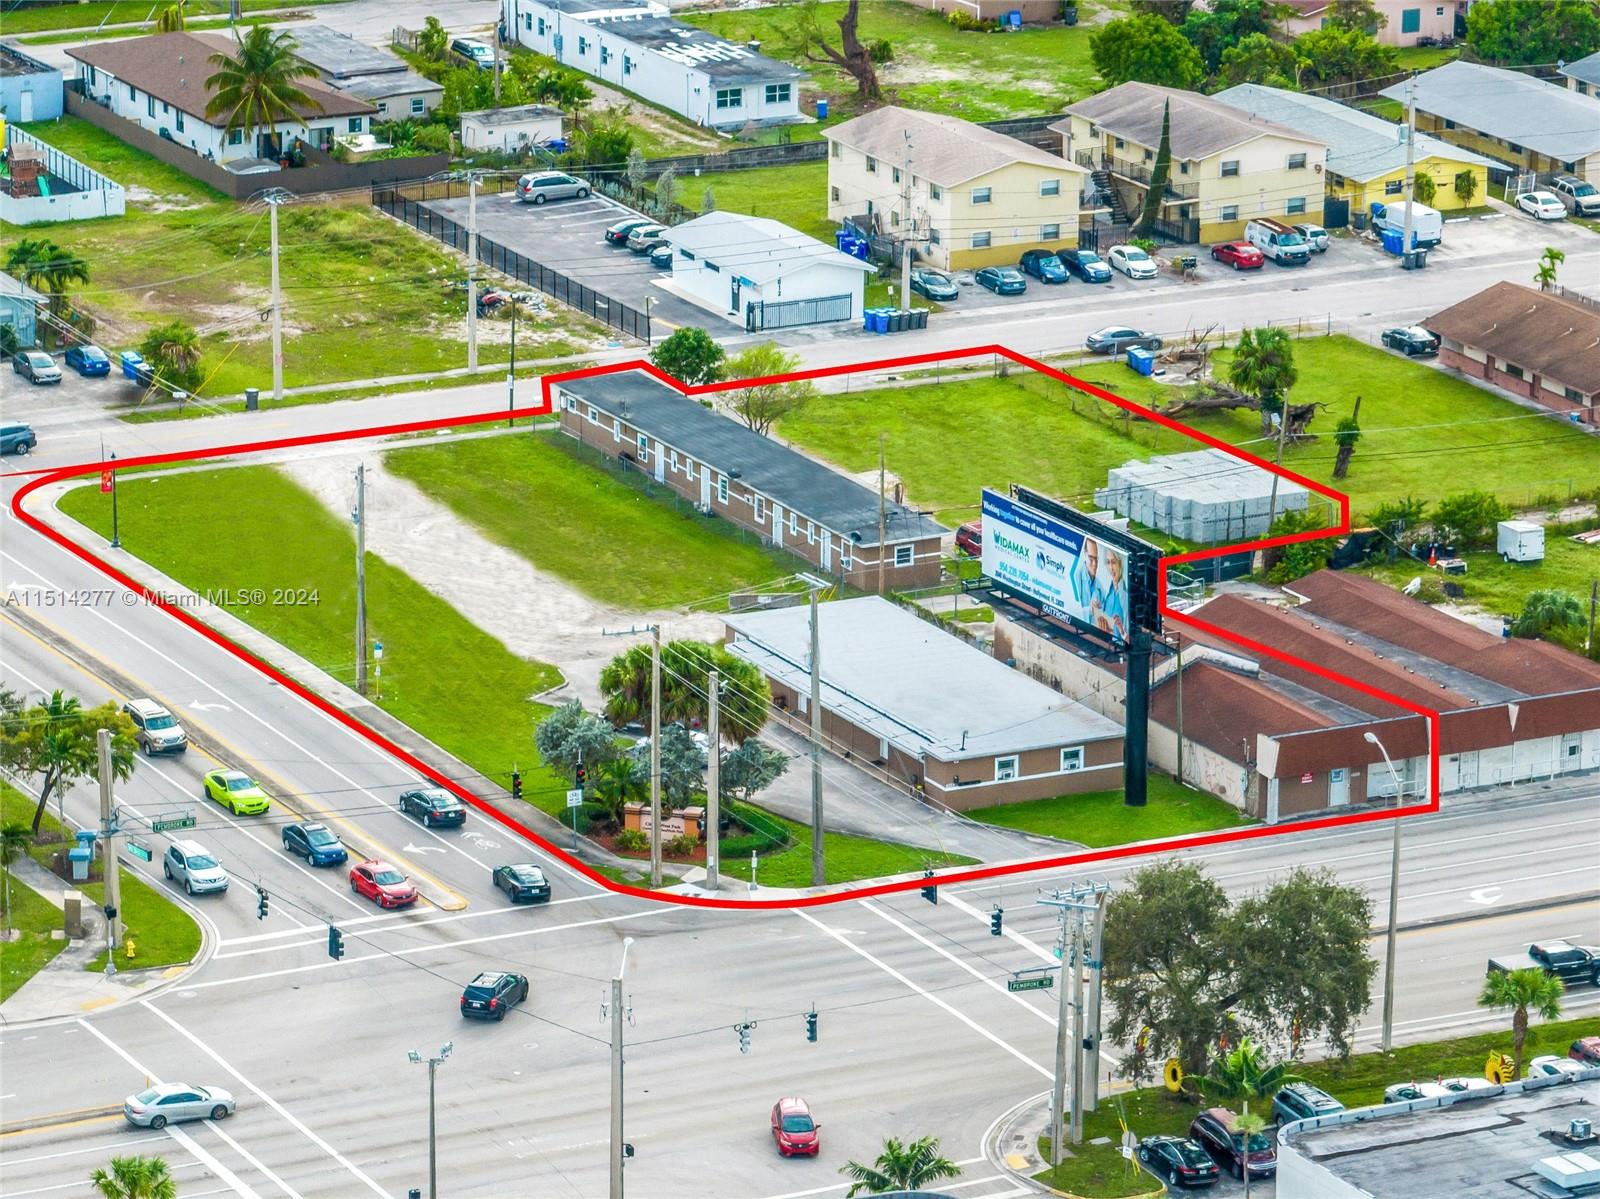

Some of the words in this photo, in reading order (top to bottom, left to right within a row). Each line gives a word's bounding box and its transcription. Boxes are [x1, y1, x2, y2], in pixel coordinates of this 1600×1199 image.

[983, 501, 1000, 517] Working
[1019, 519, 1030, 529] cover
[1046, 555, 1066, 574] Simply
[1013, 981, 1039, 989] PEMBROKE
